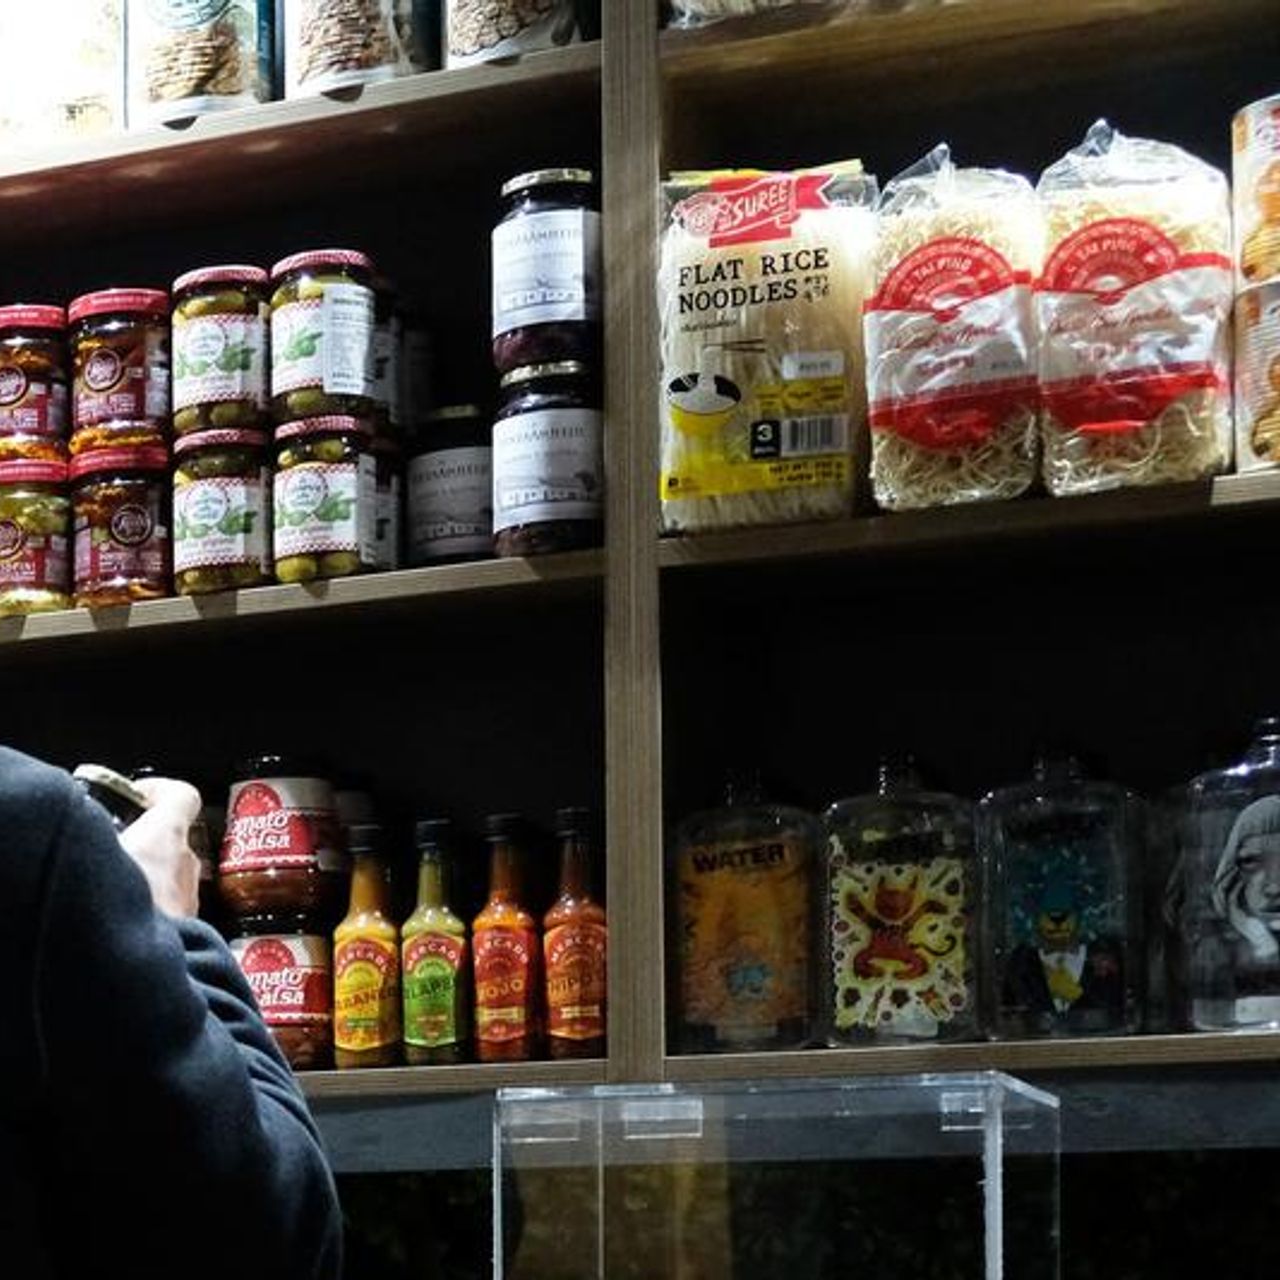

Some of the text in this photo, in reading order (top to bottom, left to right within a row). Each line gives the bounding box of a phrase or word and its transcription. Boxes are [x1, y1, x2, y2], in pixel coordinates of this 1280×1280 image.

[679, 248, 830, 288] FLAT RICE
[679, 278, 799, 314] NOODLES
[755, 423, 774, 443] 3
[690, 841, 787, 875] WATER
[256, 985, 306, 1008] alsa
